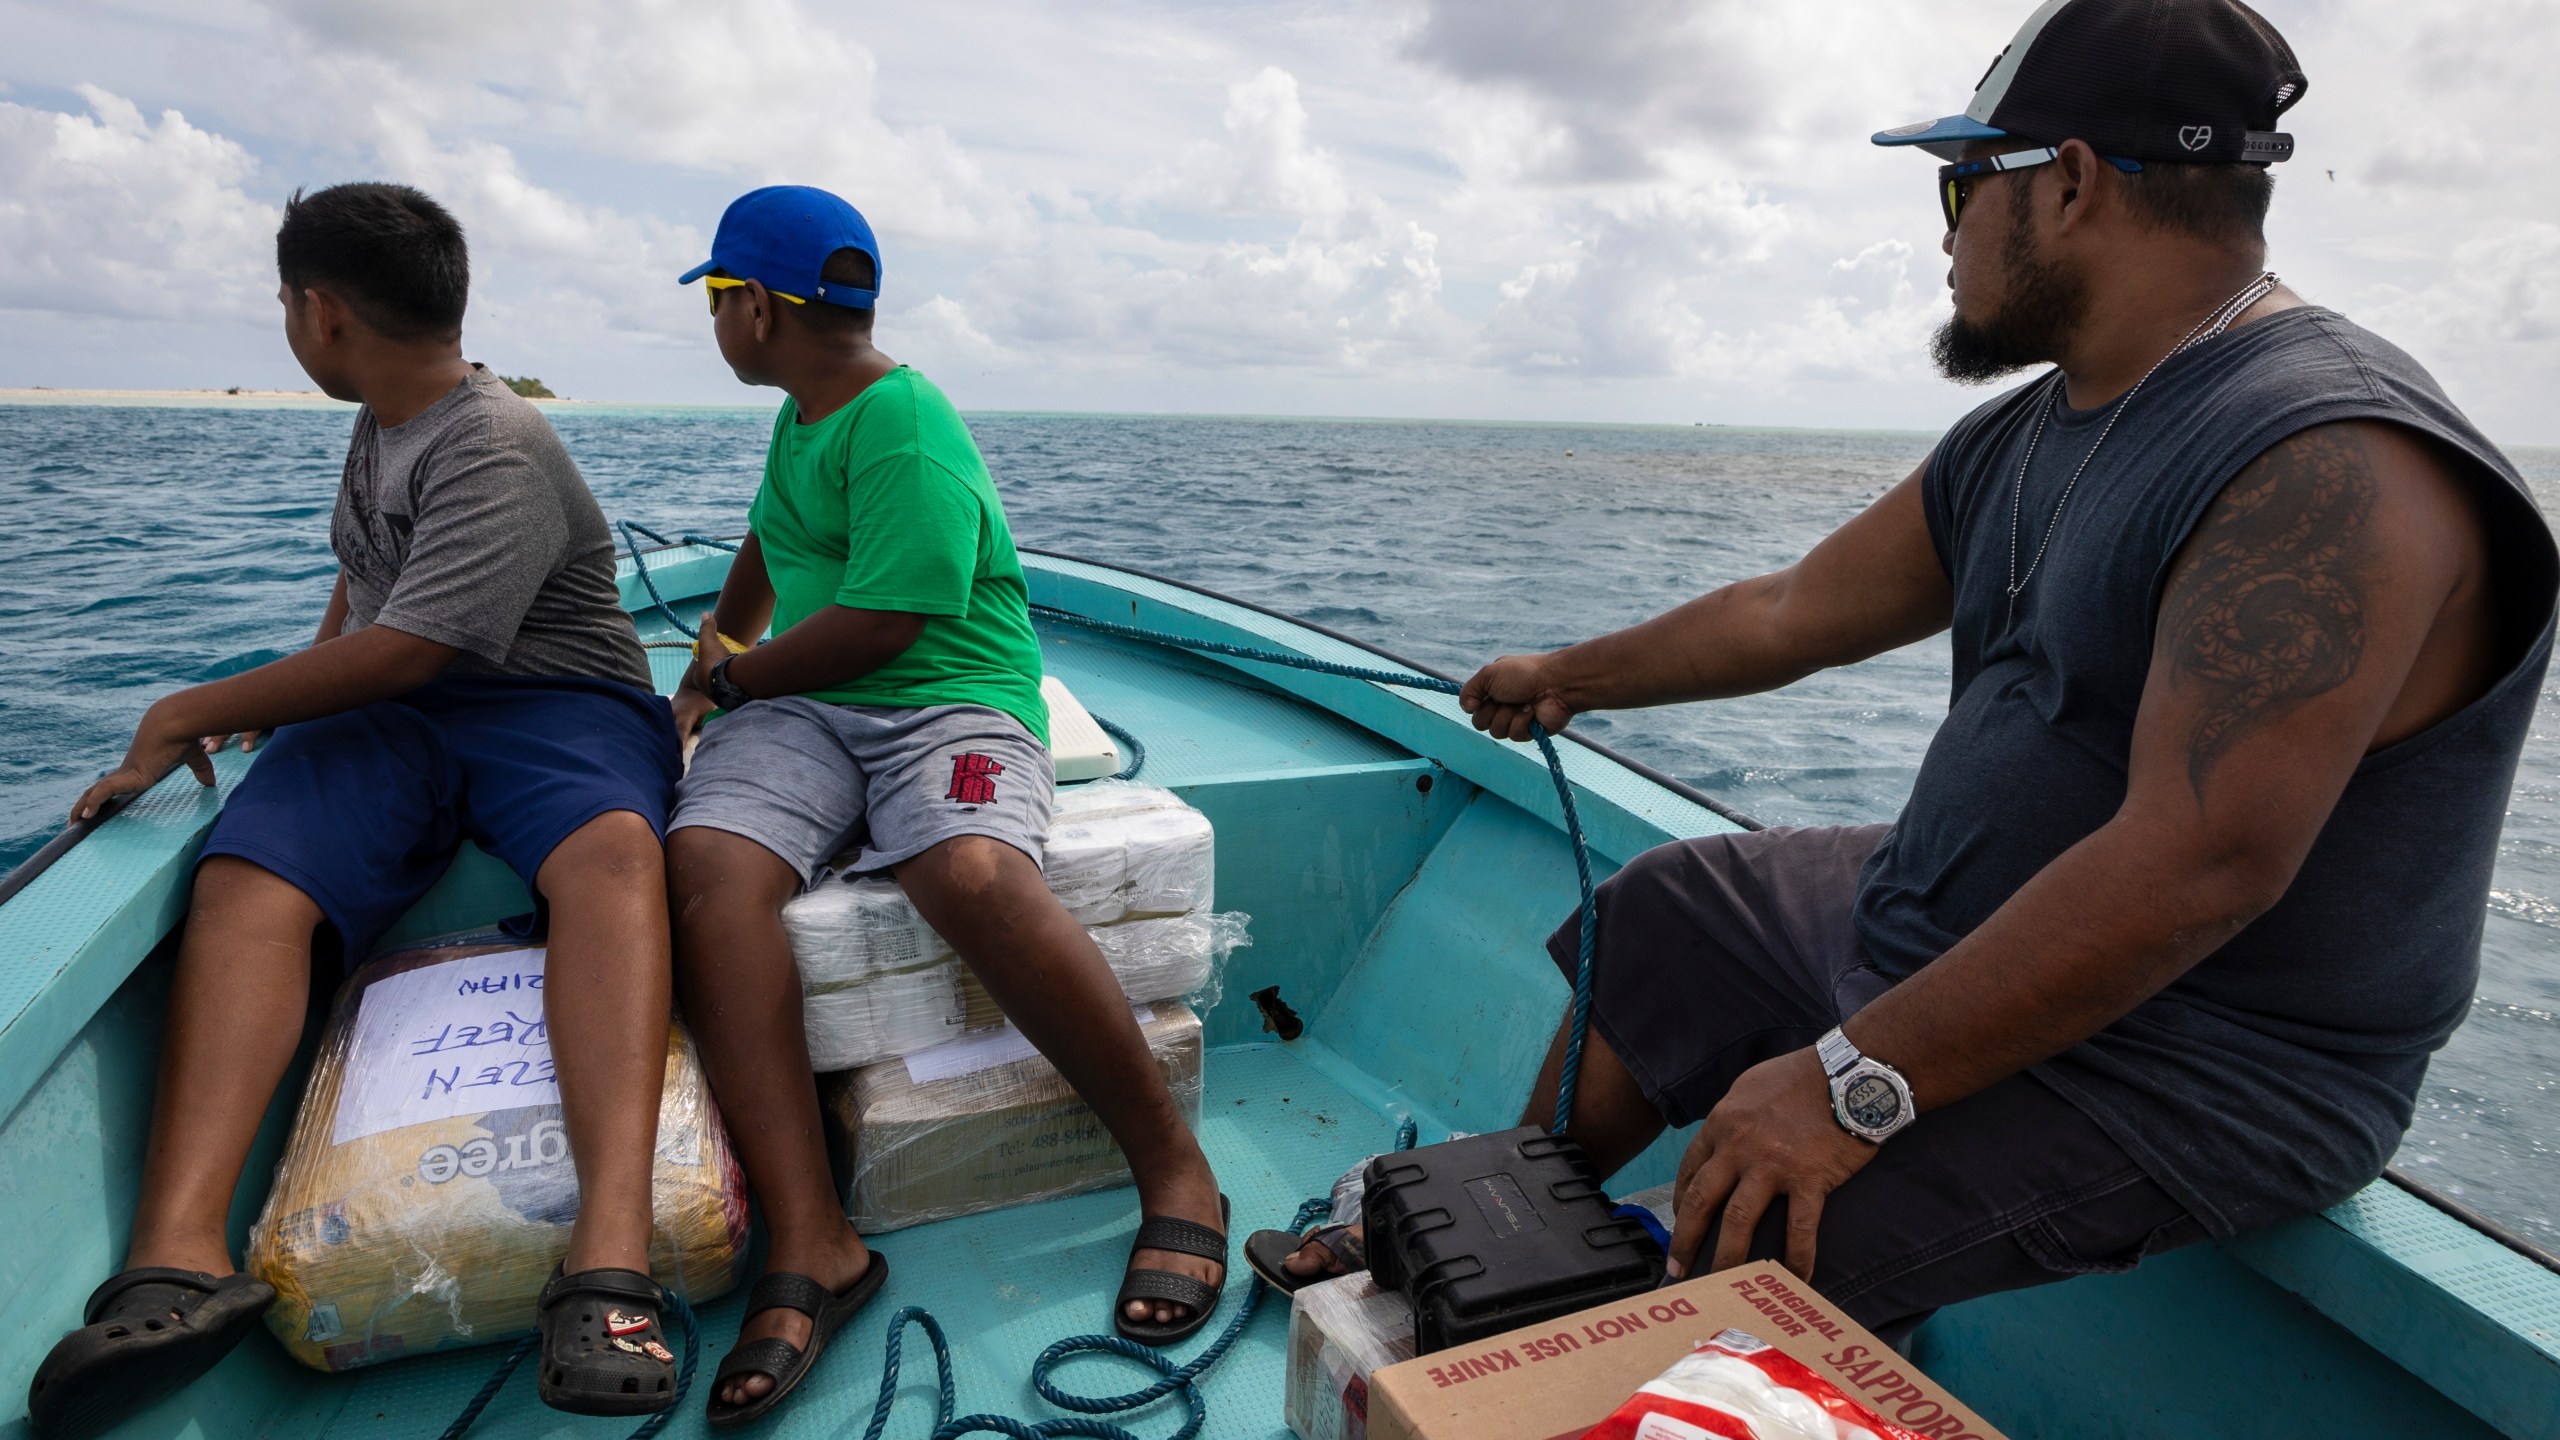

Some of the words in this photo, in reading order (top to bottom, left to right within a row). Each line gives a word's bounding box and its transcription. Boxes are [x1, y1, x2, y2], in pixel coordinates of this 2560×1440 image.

[411, 1010, 549, 1056] REEF
[997, 1141, 1025, 1157] Tel:
[1647, 1298, 1699, 1323] DO
[1730, 1279, 1808, 1338] FLAVOR
[1754, 1273, 1845, 1342] ORIGINAL
[1519, 1332, 1583, 1362] USE
[1582, 1312, 1649, 1345] NOT
[1426, 1349, 1522, 1389] KNIFE
[1821, 1345, 1985, 1440] SAPPOR
